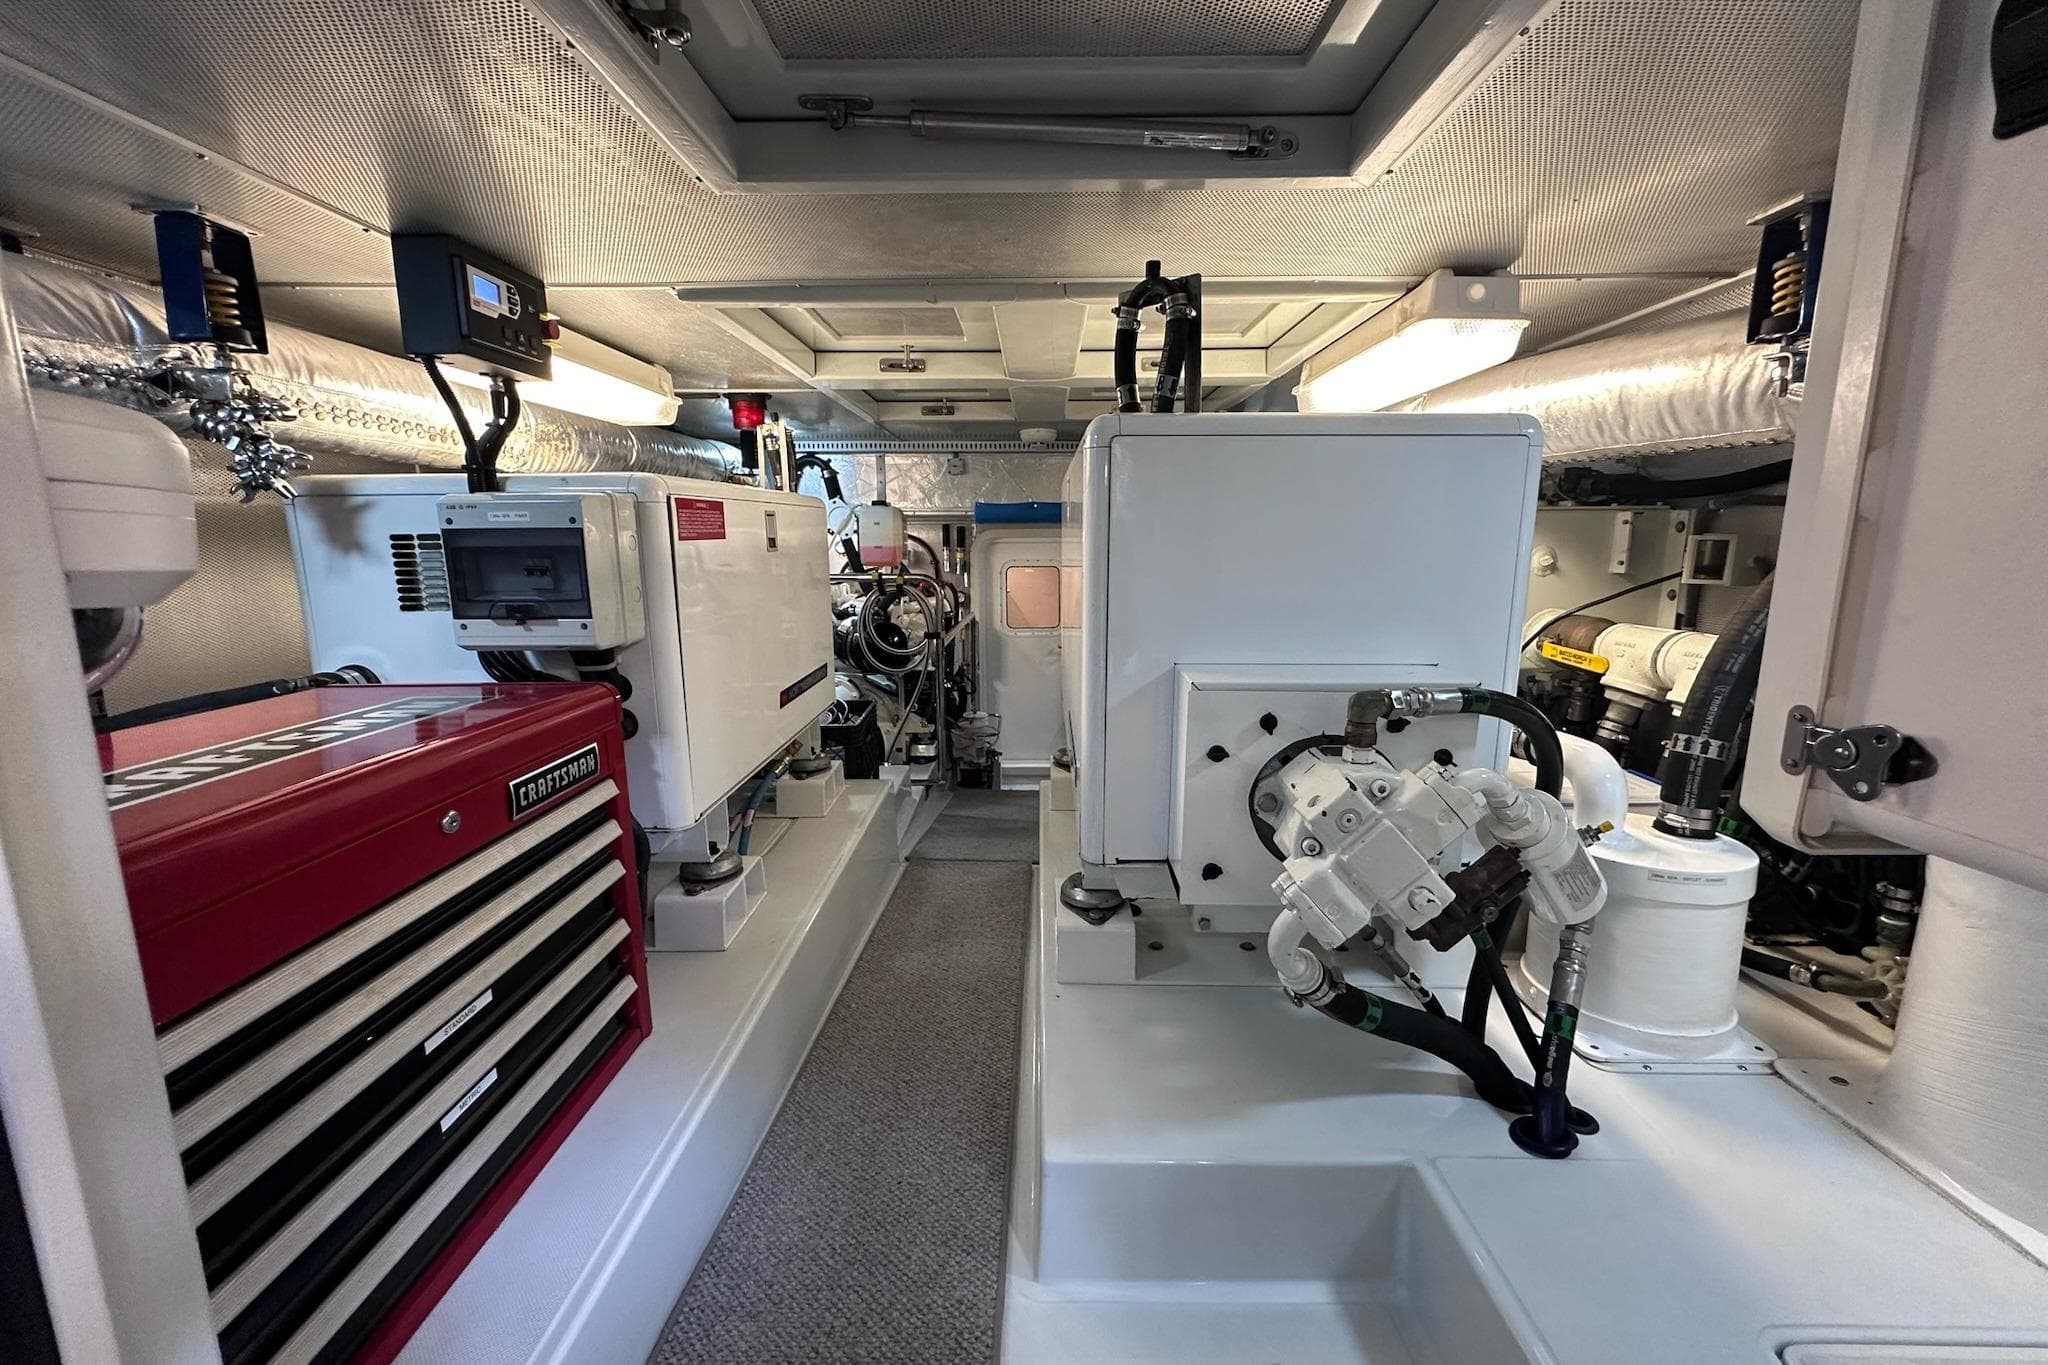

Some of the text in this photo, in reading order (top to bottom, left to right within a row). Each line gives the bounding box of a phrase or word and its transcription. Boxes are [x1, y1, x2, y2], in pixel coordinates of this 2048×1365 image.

[519, 753, 596, 807] CRAFTSMAN
[443, 1004, 477, 1036] STANDARD
[459, 1085, 482, 1110] METRIC
